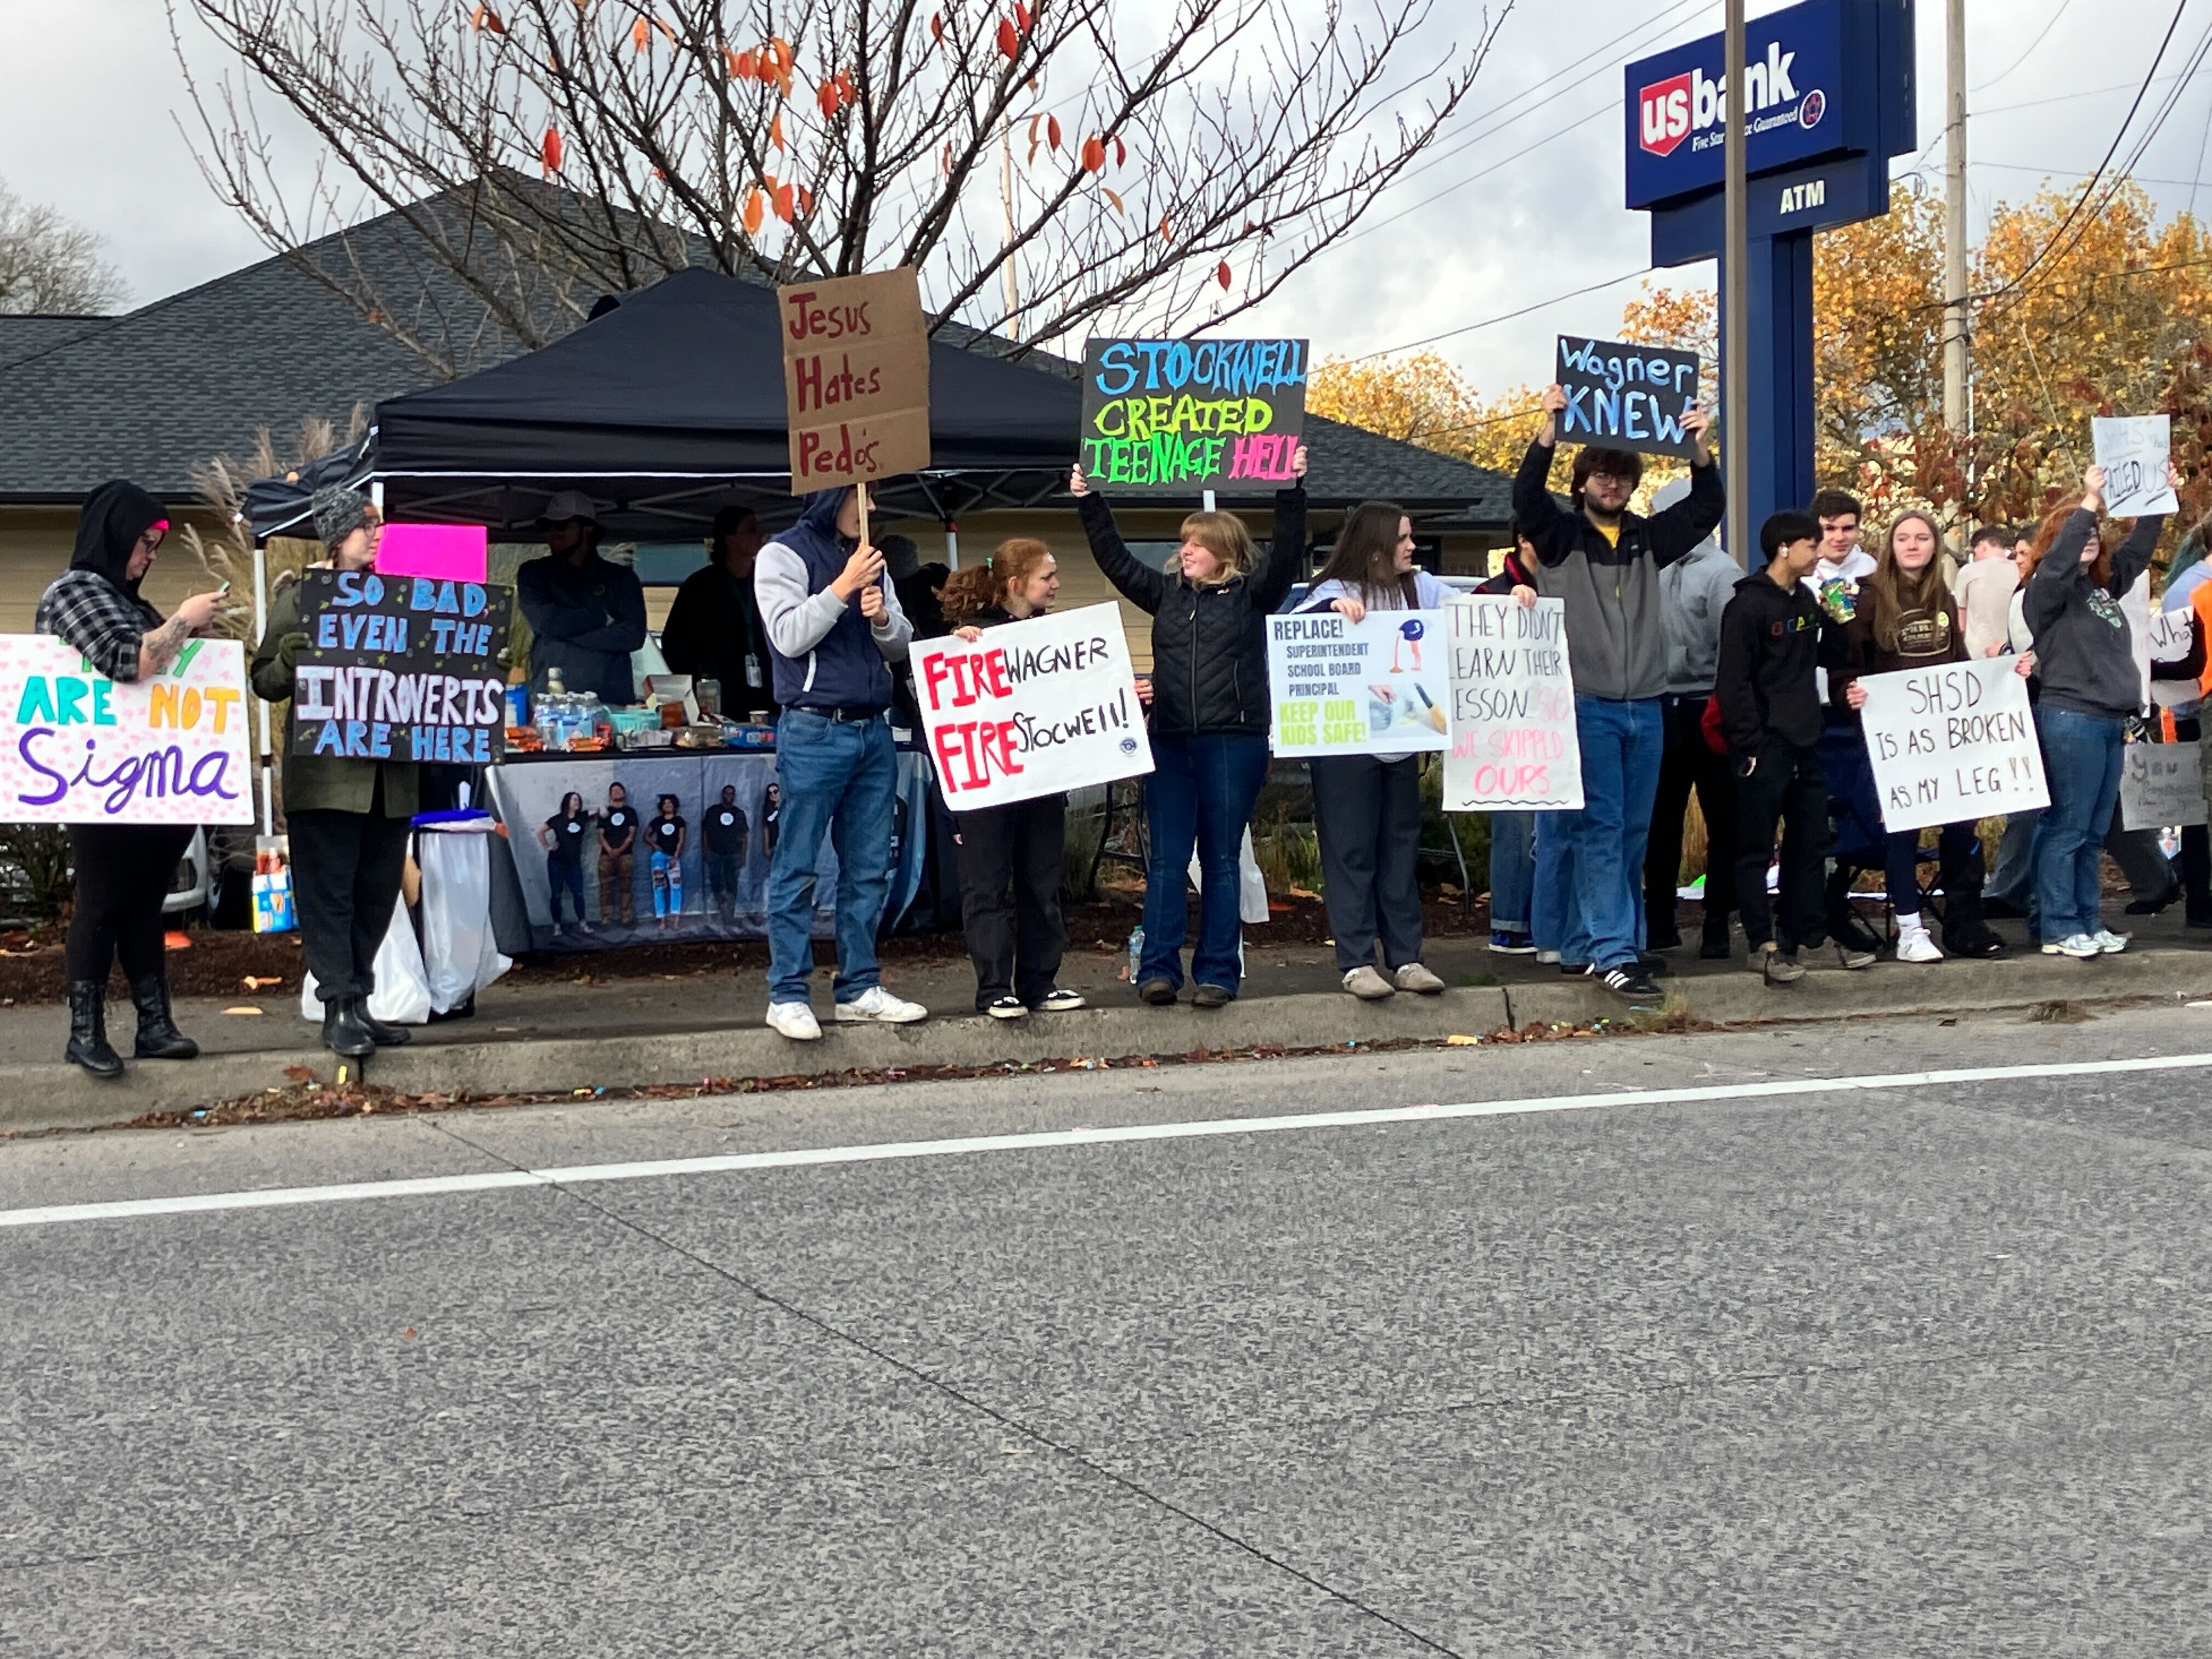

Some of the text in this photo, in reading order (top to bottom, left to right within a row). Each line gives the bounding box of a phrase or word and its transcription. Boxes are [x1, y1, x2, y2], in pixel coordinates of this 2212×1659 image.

[1780, 180, 1825, 215] ATM
[789, 292, 871, 340] Jesus
[795, 353, 881, 413] Hates
[1097, 339, 1309, 397] STOCKWELL
[1560, 338, 1694, 393] Wagner
[1093, 393, 1273, 441] CREATED
[1564, 384, 1692, 444] KNEW
[1084, 432, 1227, 486] TEENAGE
[331, 572, 385, 607] SO
[317, 614, 493, 656] EVEN THE
[1274, 618, 1344, 641] REPLACE!
[1445, 603, 1508, 640] THEY
[1286, 642, 1369, 659] SUPERINTENDENT
[1288, 662, 1362, 678] SCHOOL BOARD
[1449, 647, 1563, 680] EARN THEIR
[296, 665, 504, 726] INTROVERTS
[922, 637, 1109, 710] FIRE WAGNER
[1289, 682, 1340, 697] PRINCIPAL
[1906, 670, 1982, 714] SHSD
[16, 676, 241, 734] ARE NOT
[1279, 699, 1356, 724] KEEP OUR
[1452, 686, 1571, 722] ESSON SO
[314, 719, 491, 763] ARE HERE
[1280, 722, 1367, 746] KIDS SAFE!
[1876, 711, 2026, 761] IS AS BROKEN
[18, 727, 239, 814] Sigma
[934, 720, 1024, 793] FIRE
[1474, 764, 1550, 795] OURS
[1891, 786, 1913, 810] AS
[1918, 777, 1939, 804] MY
